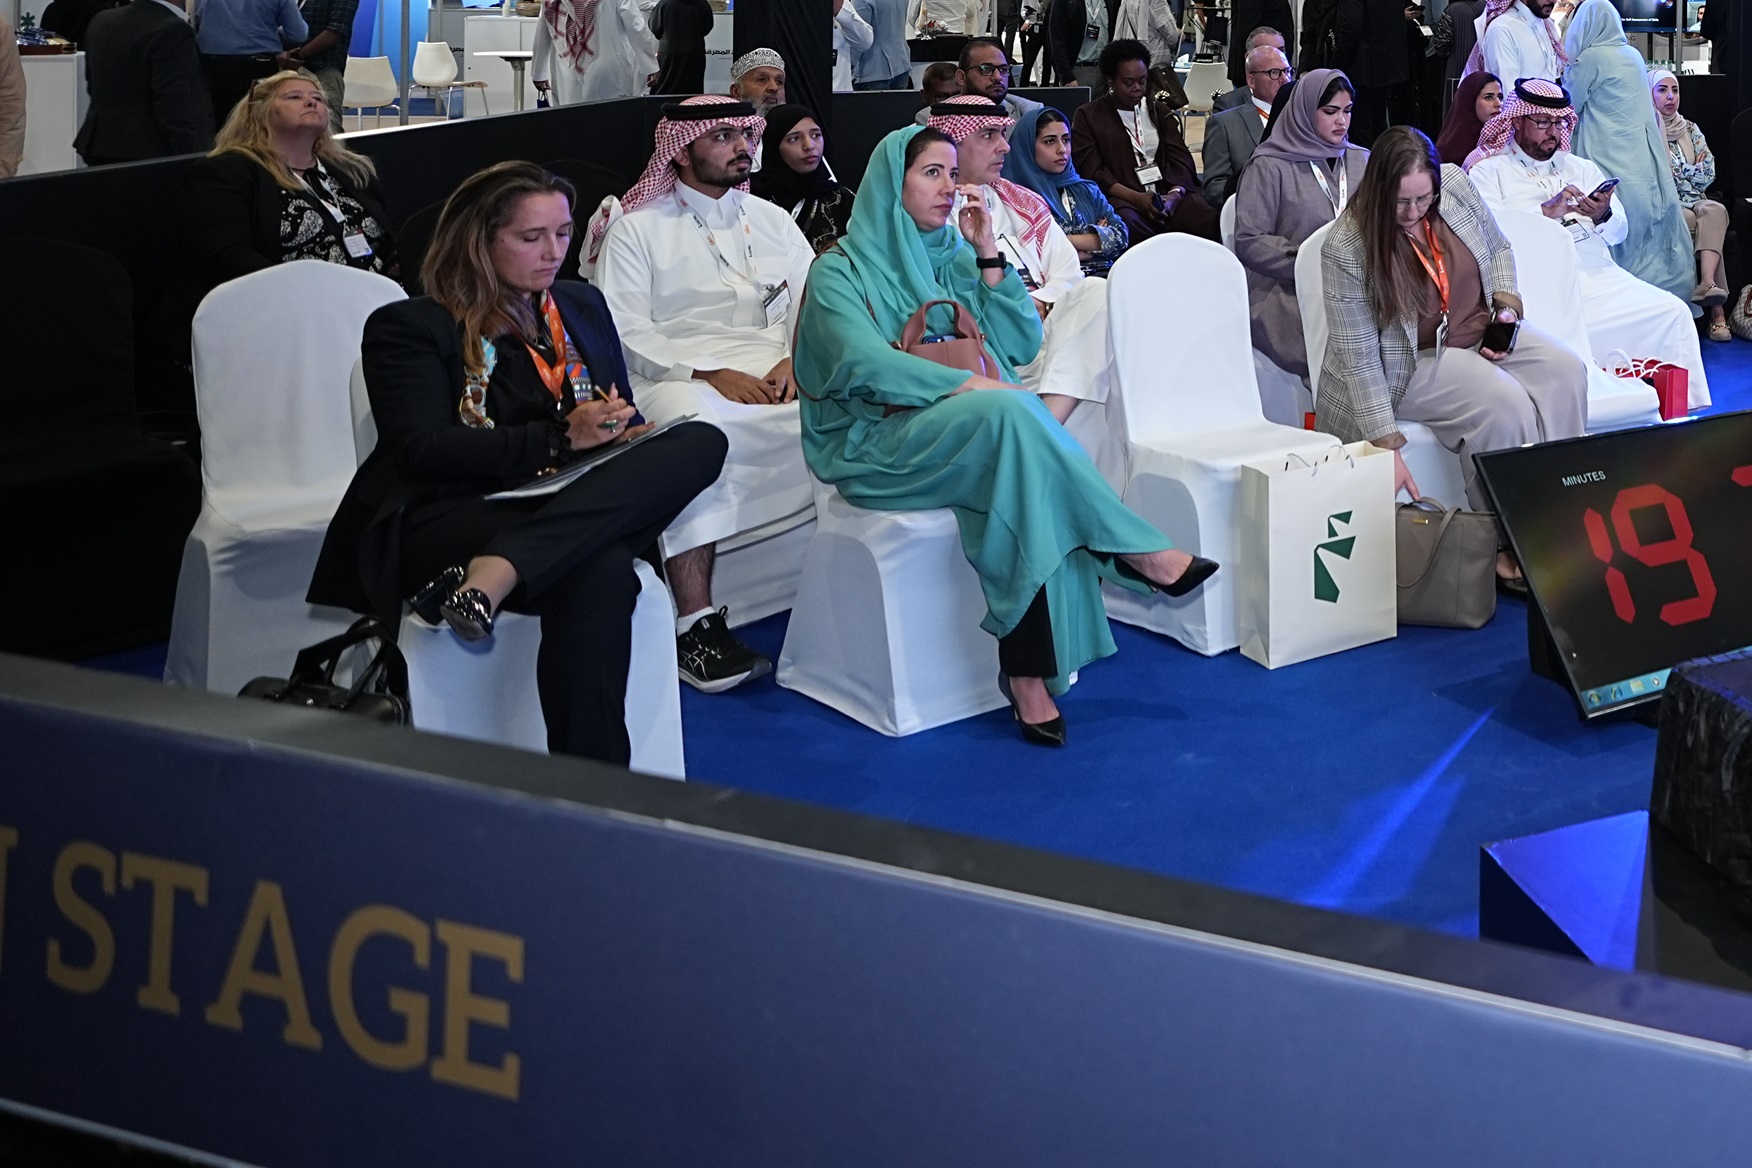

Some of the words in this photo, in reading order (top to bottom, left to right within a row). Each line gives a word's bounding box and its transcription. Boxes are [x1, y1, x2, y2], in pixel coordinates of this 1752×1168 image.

[1561, 470, 1607, 487] MINUTES
[1583, 483, 1718, 627] 19
[46, 839, 525, 1103] STAGE
